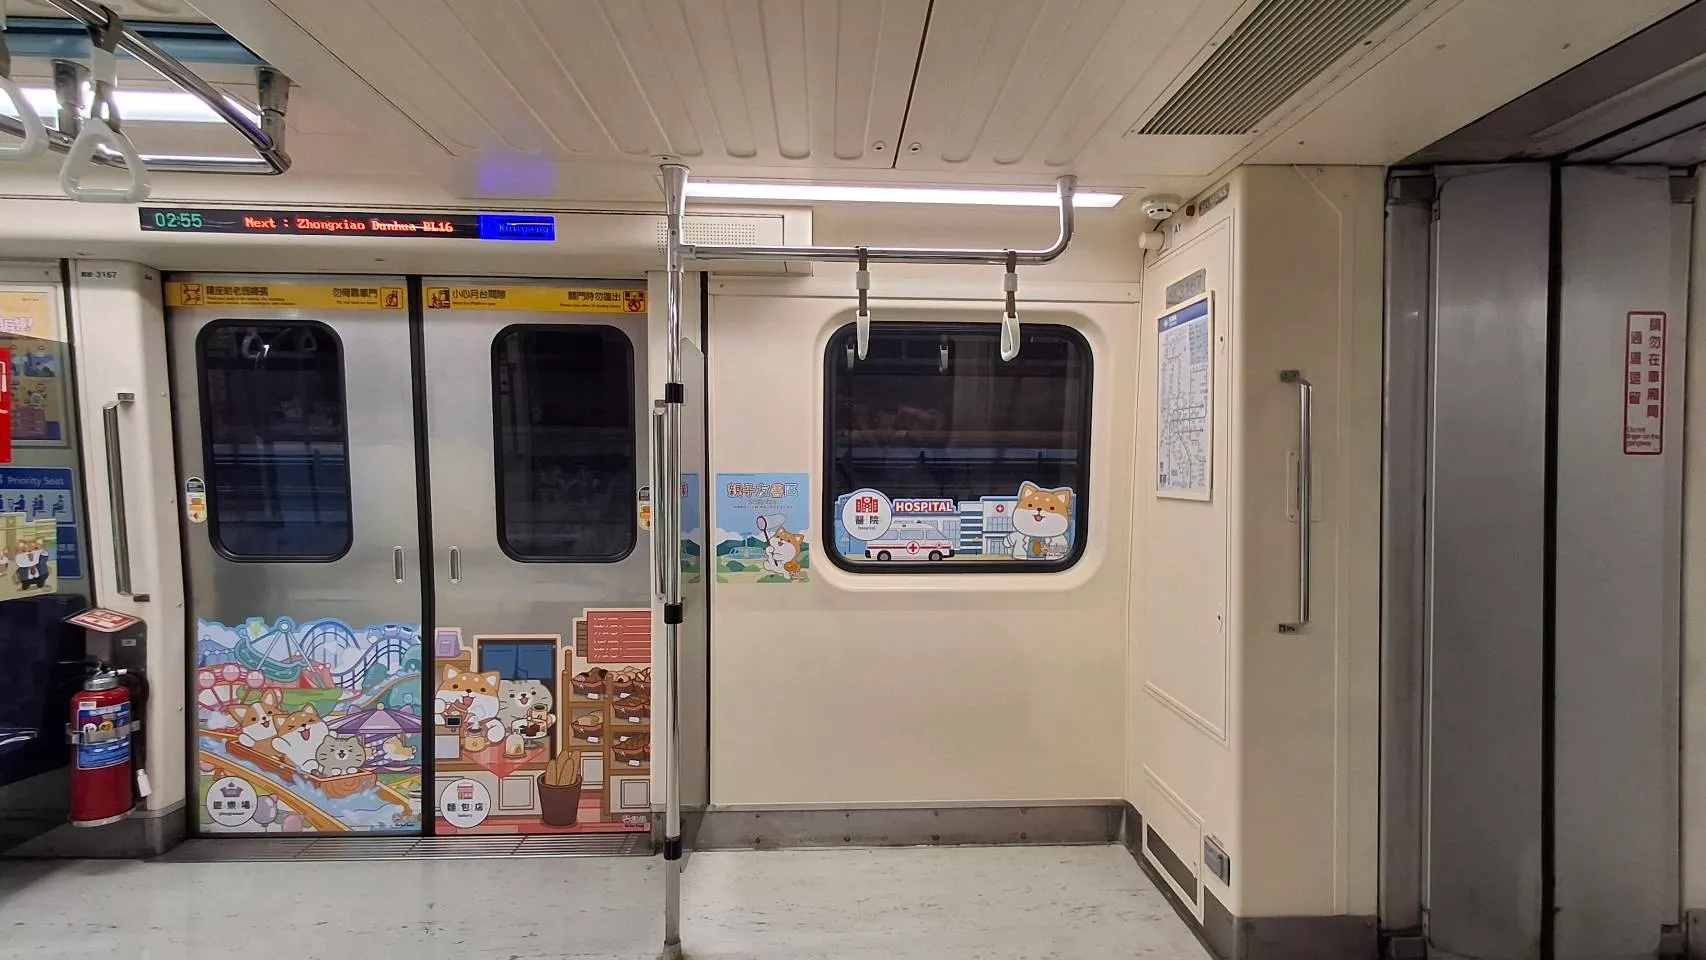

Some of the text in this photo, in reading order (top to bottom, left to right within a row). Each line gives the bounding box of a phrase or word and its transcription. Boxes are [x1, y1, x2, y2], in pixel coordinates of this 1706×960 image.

[155, 212, 202, 228] 02:55
[245, 216, 277, 229] Next
[297, 218, 365, 231] Zhongxiao
[372, 219, 416, 231] Dunhua
[423, 221, 454, 233] BL16
[8, 476, 65, 487] Priority Seat
[727, 482, 799, 498] 親子友善區
[895, 501, 953, 512] HOSPITAL
[855, 515, 880, 525] 醫院
